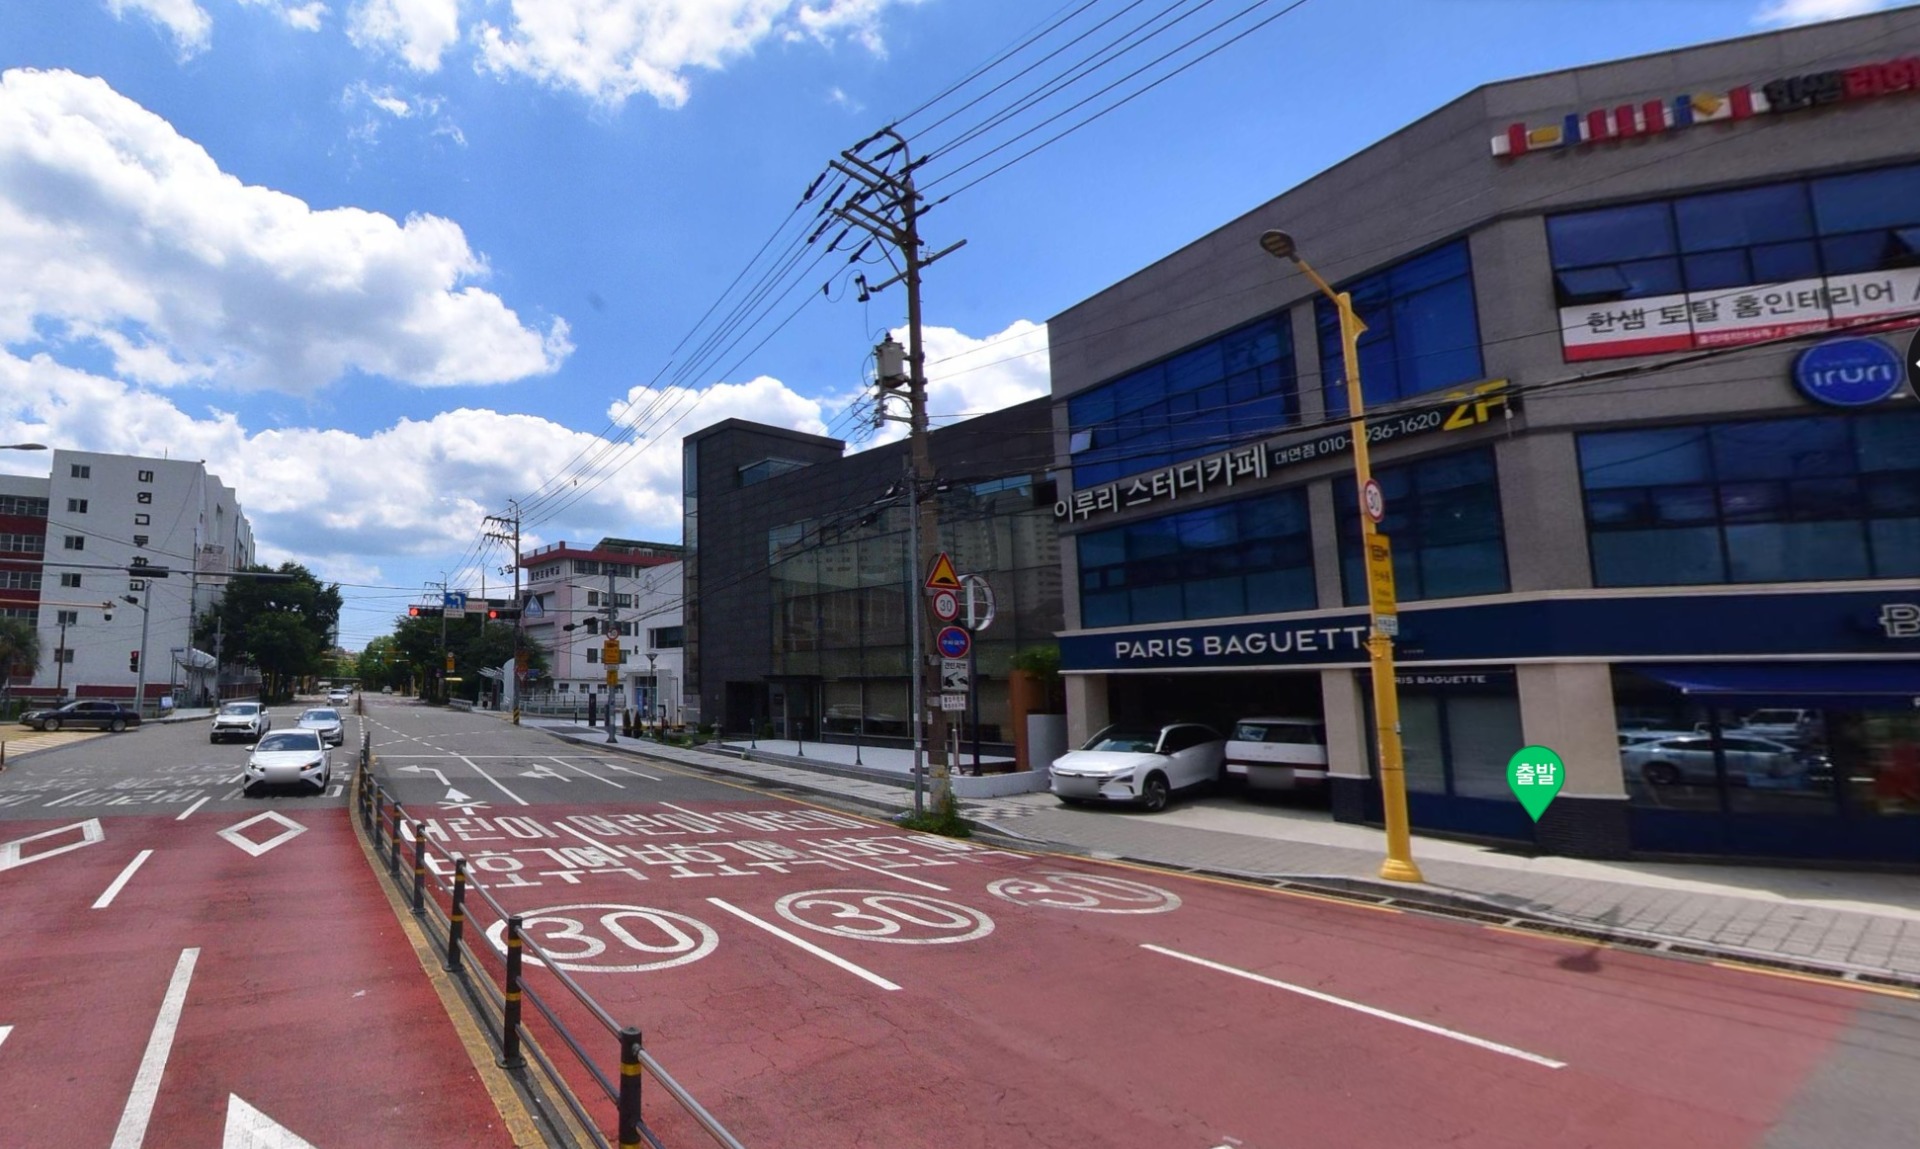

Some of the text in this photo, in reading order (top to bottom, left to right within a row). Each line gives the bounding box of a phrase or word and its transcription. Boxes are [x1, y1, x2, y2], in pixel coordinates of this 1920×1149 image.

[1586, 307, 1646, 334] 한샘
[1658, 300, 1720, 327] 토탈
[1732, 279, 1896, 319] 홈인테리어
[1274, 444, 1317, 466] 대연점
[1053, 442, 1269, 524] 이루리 스터디카페
[939, 599, 953, 613] 30
[1115, 636, 1194, 660] PARIS
[1203, 625, 1394, 656] BAGUETT
[1416, 674, 1487, 685] BAGUETTE
[400, 816, 560, 842] 어린이
[566, 813, 735, 837] 어린이
[711, 809, 881, 832] 어린이
[616, 840, 850, 879] 보호구역
[1003, 875, 1164, 907] 30
[795, 895, 972, 937] 30
[520, 911, 696, 960] 30
